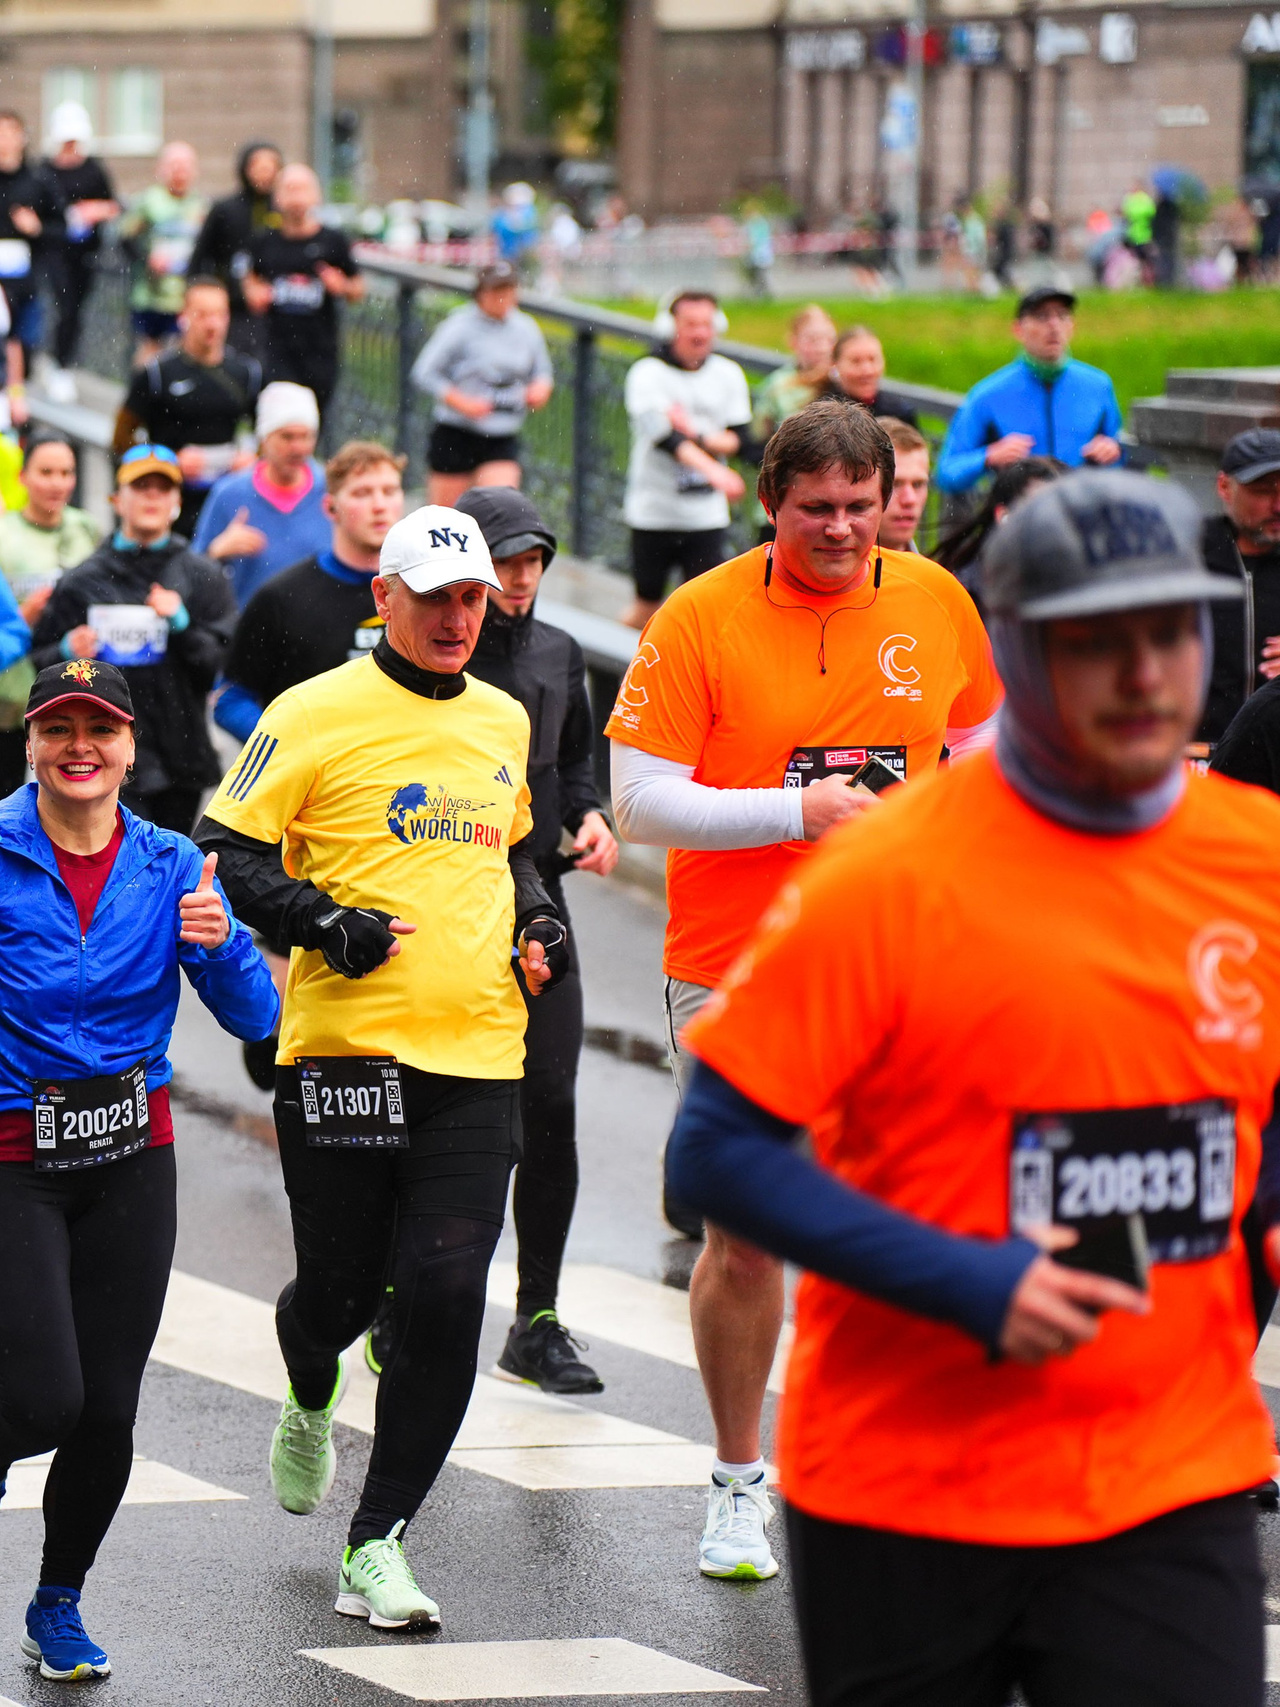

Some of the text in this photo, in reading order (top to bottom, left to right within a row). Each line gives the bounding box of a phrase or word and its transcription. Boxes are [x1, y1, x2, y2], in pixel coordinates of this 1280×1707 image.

[428, 527, 469, 553] NY
[883, 686, 922, 697] ColliCare
[893, 758, 904, 769] KM
[428, 794, 472, 810] WINGS
[434, 808, 460, 819] LIFE
[410, 818, 502, 850] WORLD RUN
[380, 1069, 399, 1078] 10 KM
[321, 1086, 381, 1116] 21307
[62, 1098, 134, 1140] 20023
[89, 1136, 114, 1150] RENATA
[1058, 1148, 1197, 1219] 20833
